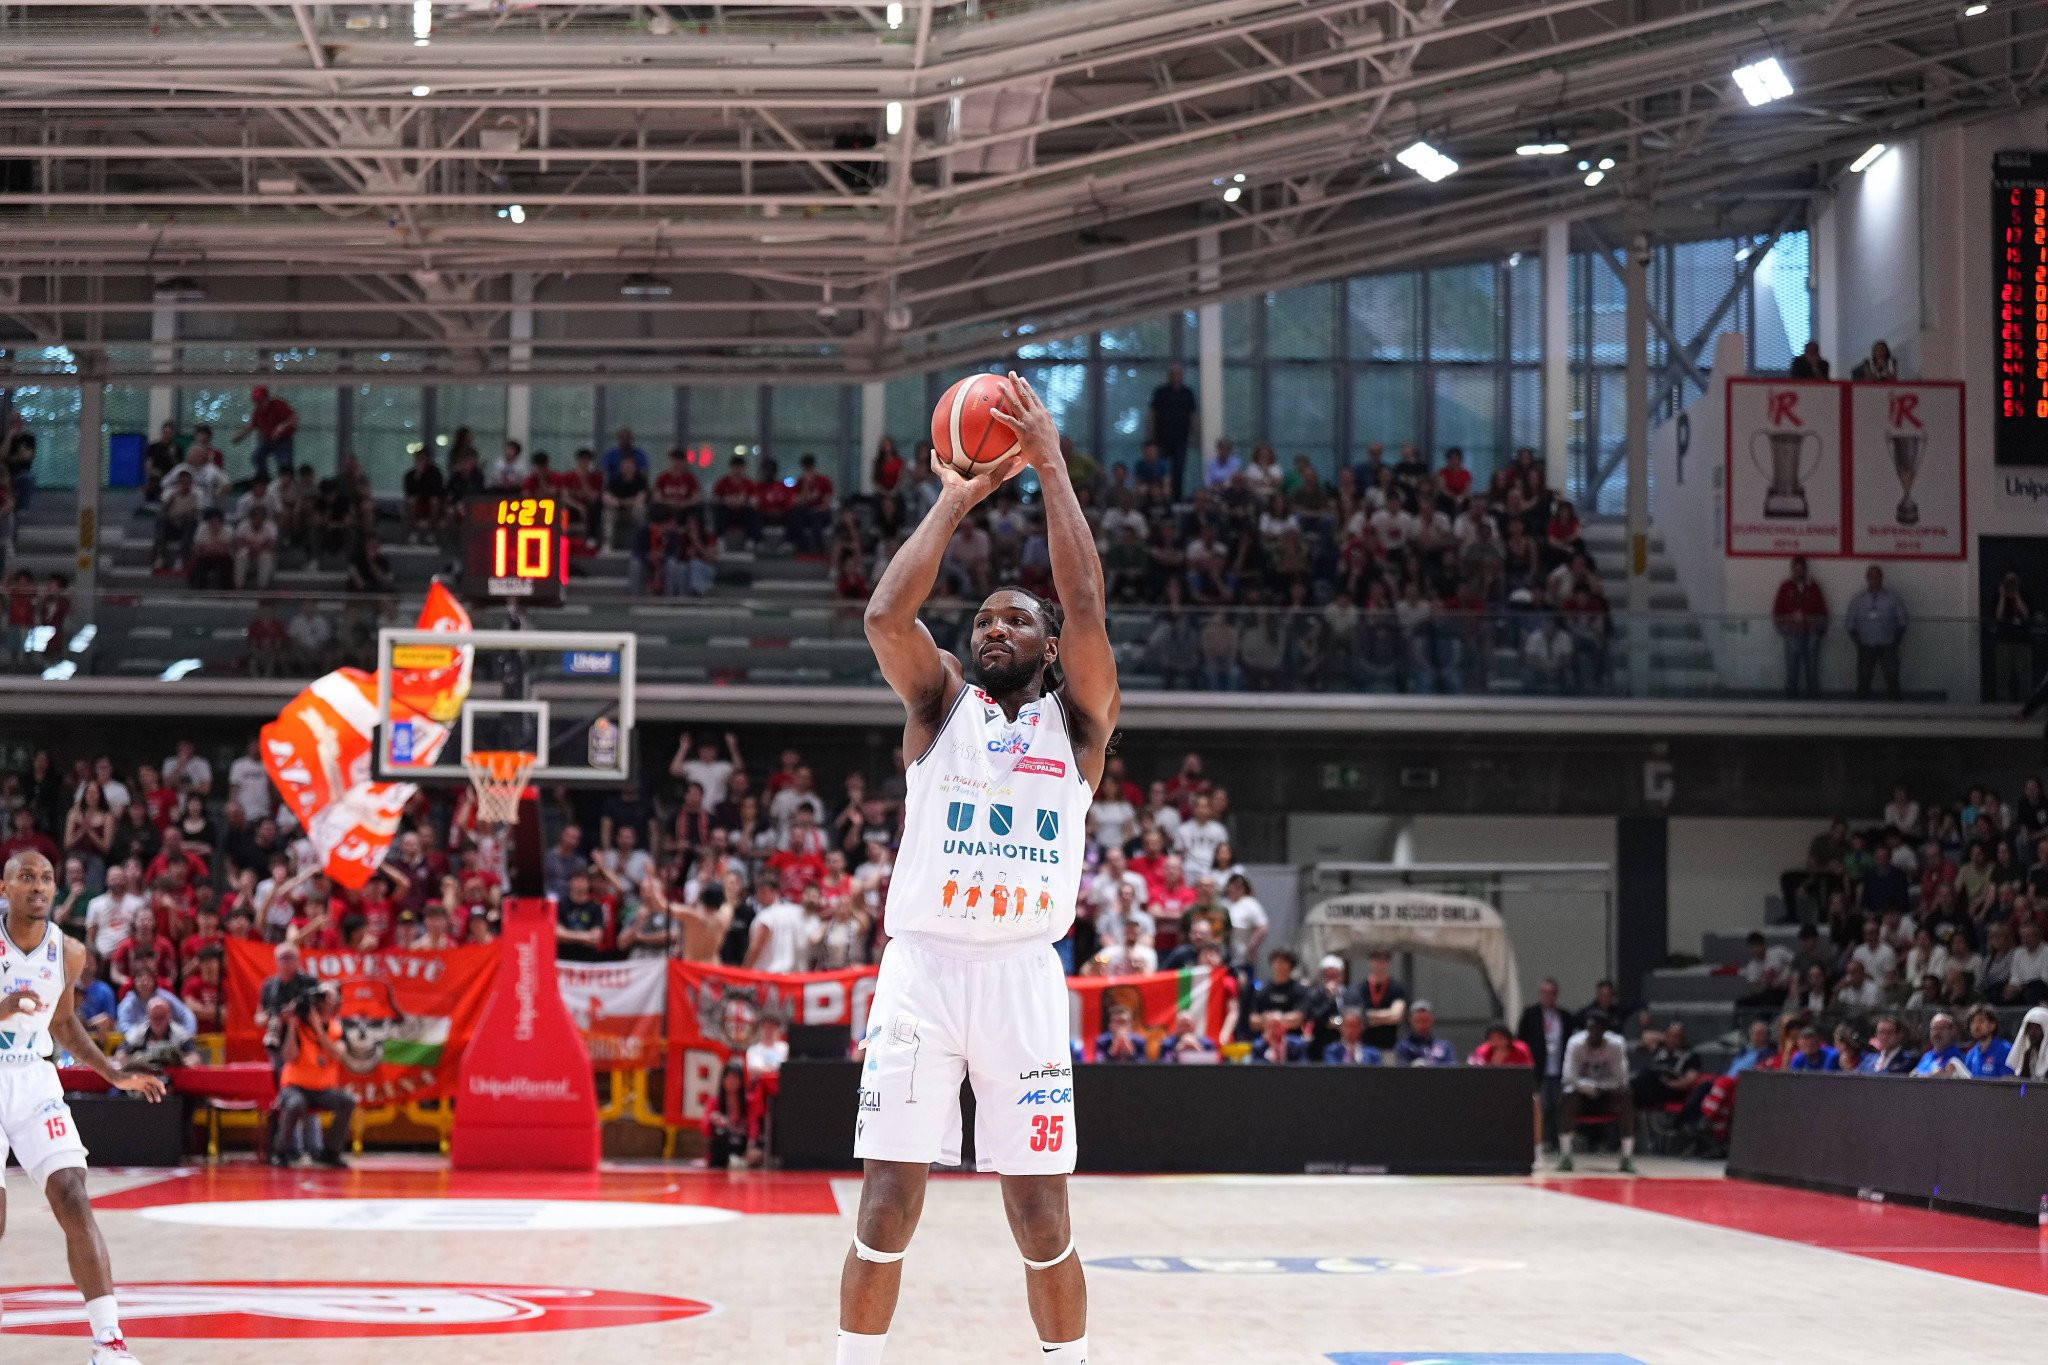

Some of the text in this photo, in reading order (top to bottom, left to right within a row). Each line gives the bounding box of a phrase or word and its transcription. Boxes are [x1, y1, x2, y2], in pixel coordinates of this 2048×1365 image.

[497, 499, 555, 526] 1:27
[495, 527, 551, 578] 10
[943, 839, 1060, 865] UNAHOTELS
[1020, 1070, 1039, 1079] LA
[44, 1116, 66, 1140] 15
[1030, 1115, 1064, 1152] 35
